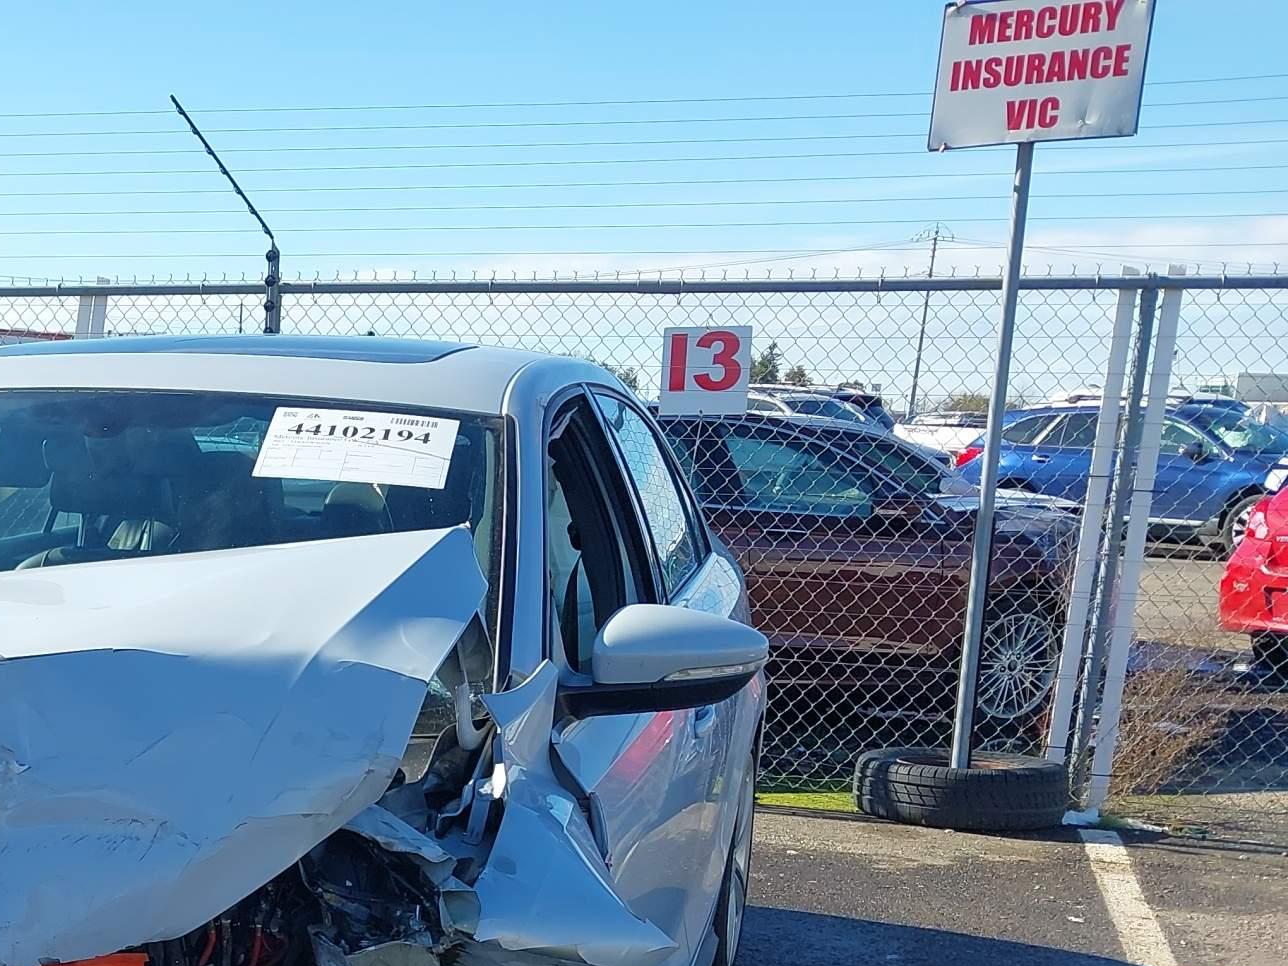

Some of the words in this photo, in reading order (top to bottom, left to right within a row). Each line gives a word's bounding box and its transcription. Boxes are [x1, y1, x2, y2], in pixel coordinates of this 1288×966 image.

[968, 0, 1125, 46] MERCURY
[950, 44, 1132, 92] INSURANCE
[1006, 97, 1060, 131] VIC
[669, 331, 741, 392] 13
[287, 422, 431, 445] 44102194
